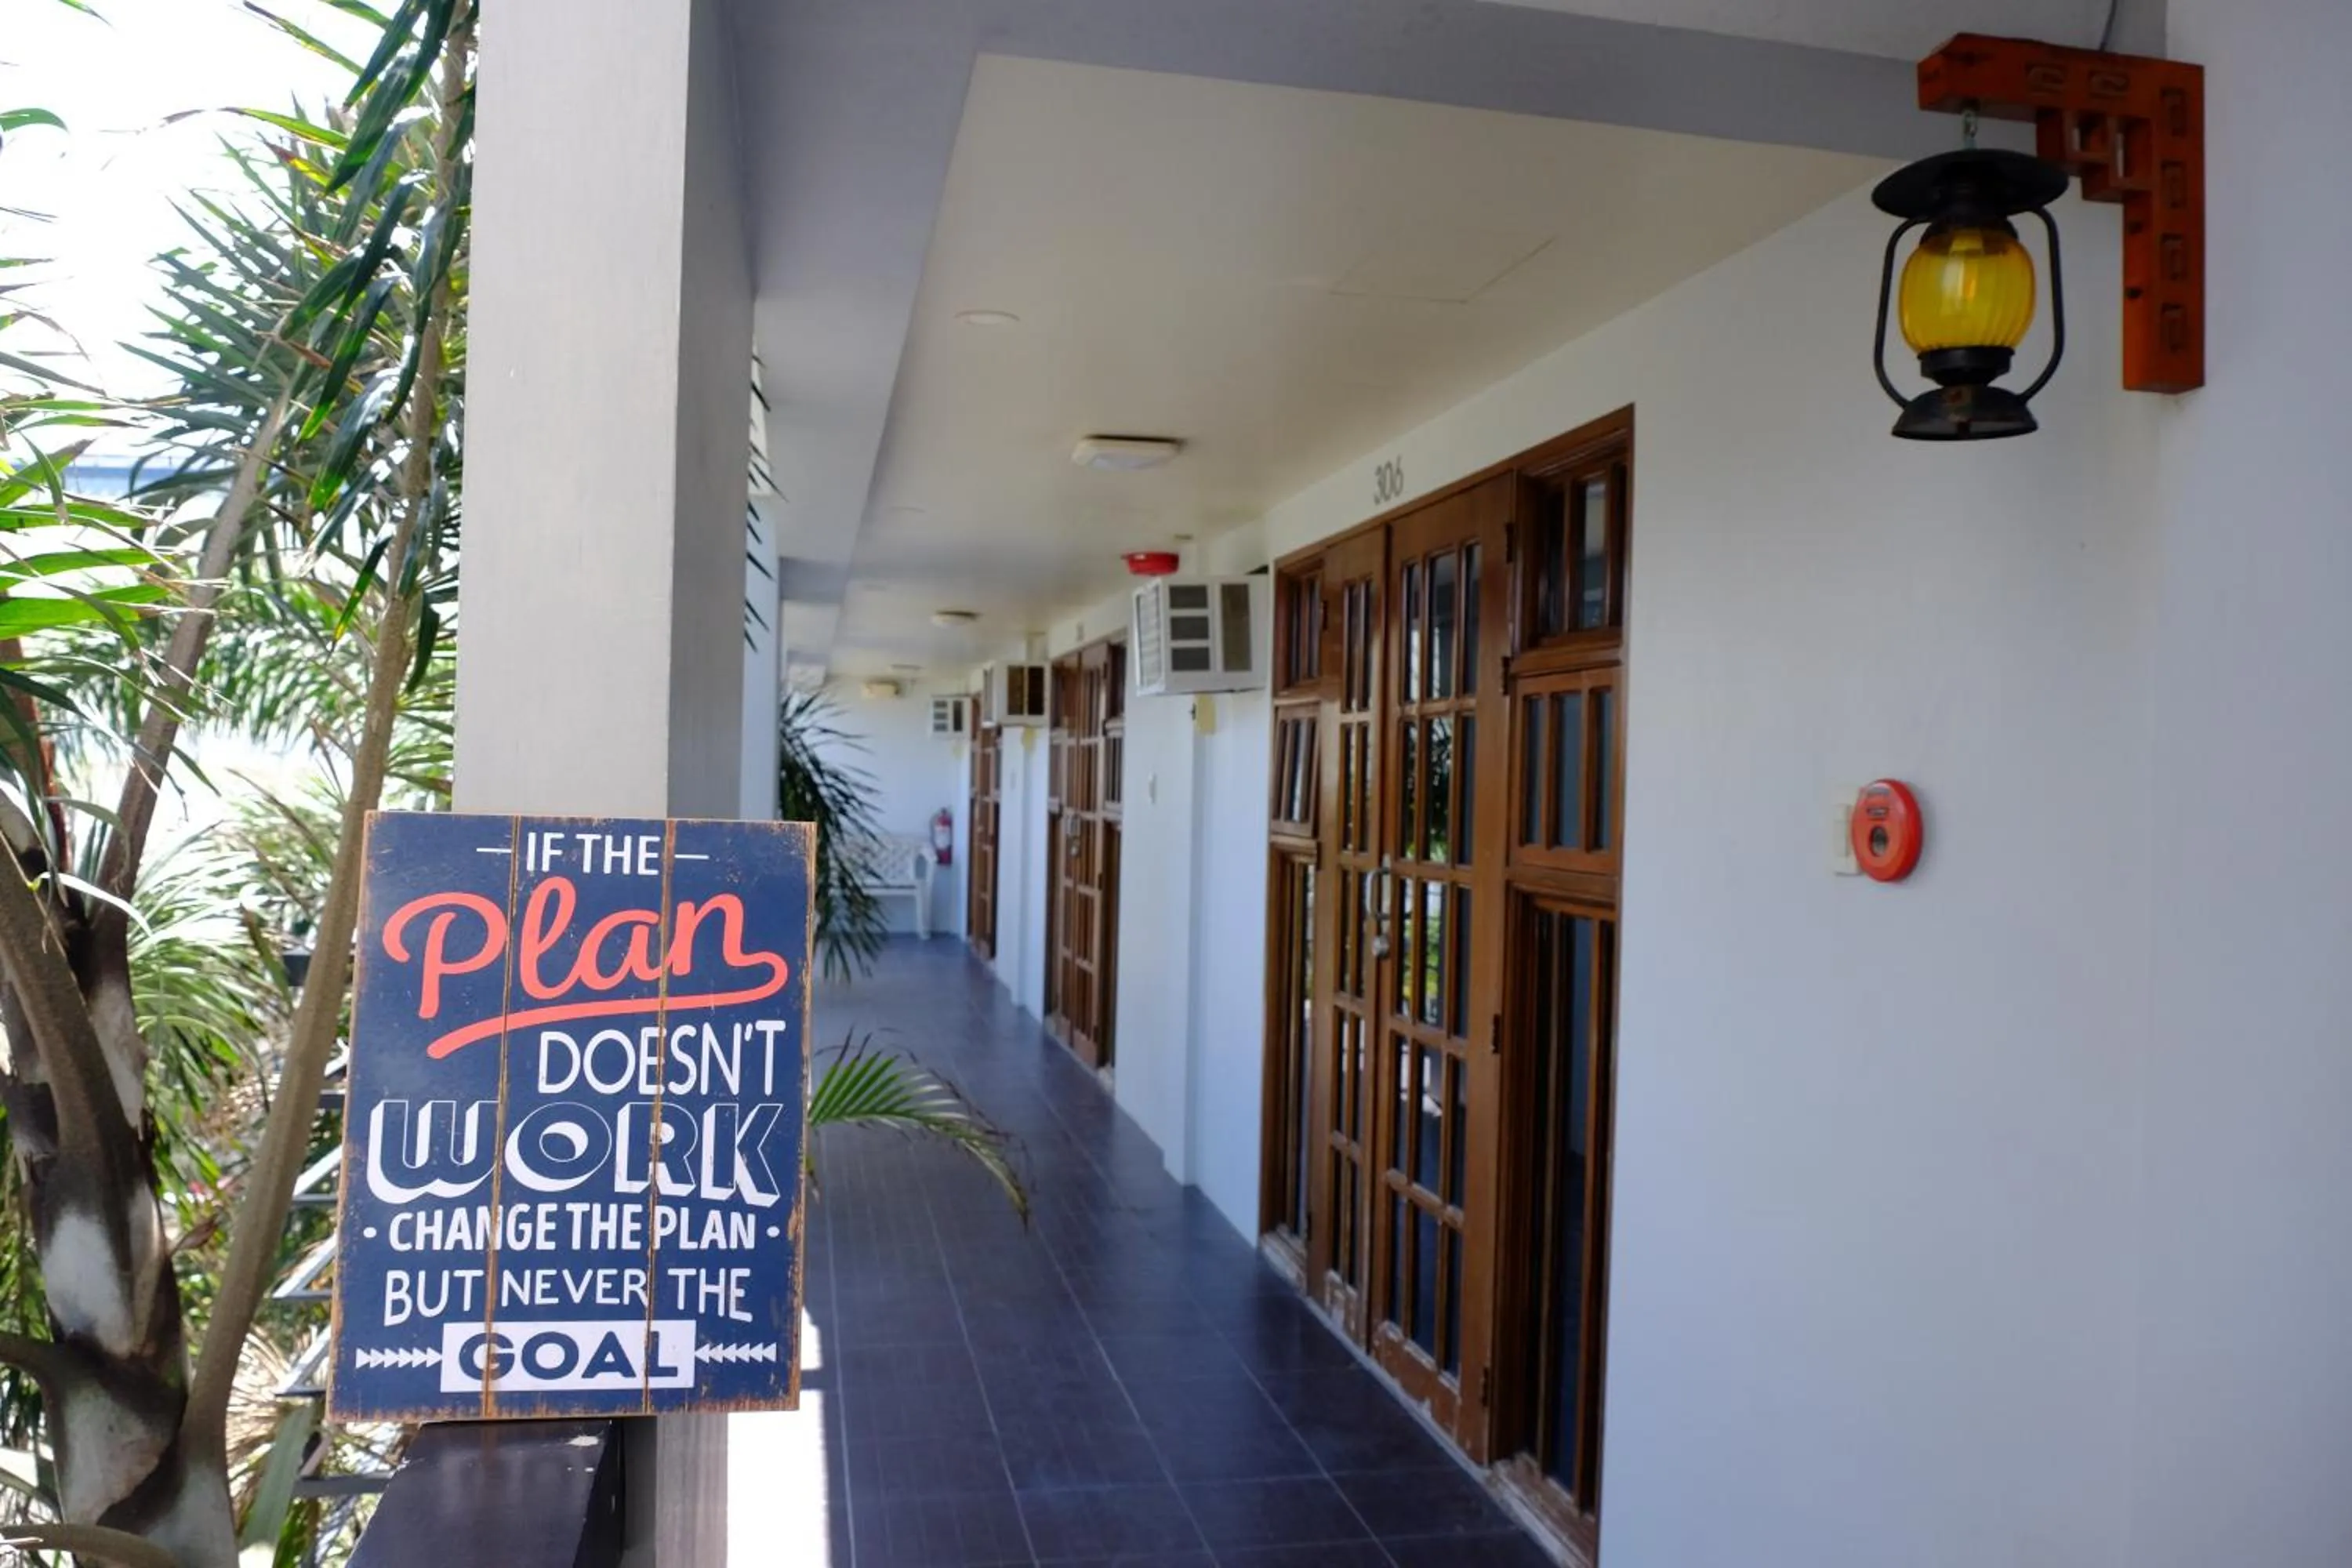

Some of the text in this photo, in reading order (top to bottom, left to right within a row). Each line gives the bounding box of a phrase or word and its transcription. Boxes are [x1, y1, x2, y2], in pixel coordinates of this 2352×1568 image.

[1374, 453, 1404, 506] 306
[526, 832, 661, 876] IF THE
[382, 876, 789, 1019] Plan
[538, 1020, 786, 1096] DOESN'T
[366, 1099, 784, 1208] WORK
[389, 1203, 756, 1252] CHANGE THE PLAN
[383, 1268, 753, 1327] BUT NEVER THE
[458, 1330, 680, 1381] GOAL
